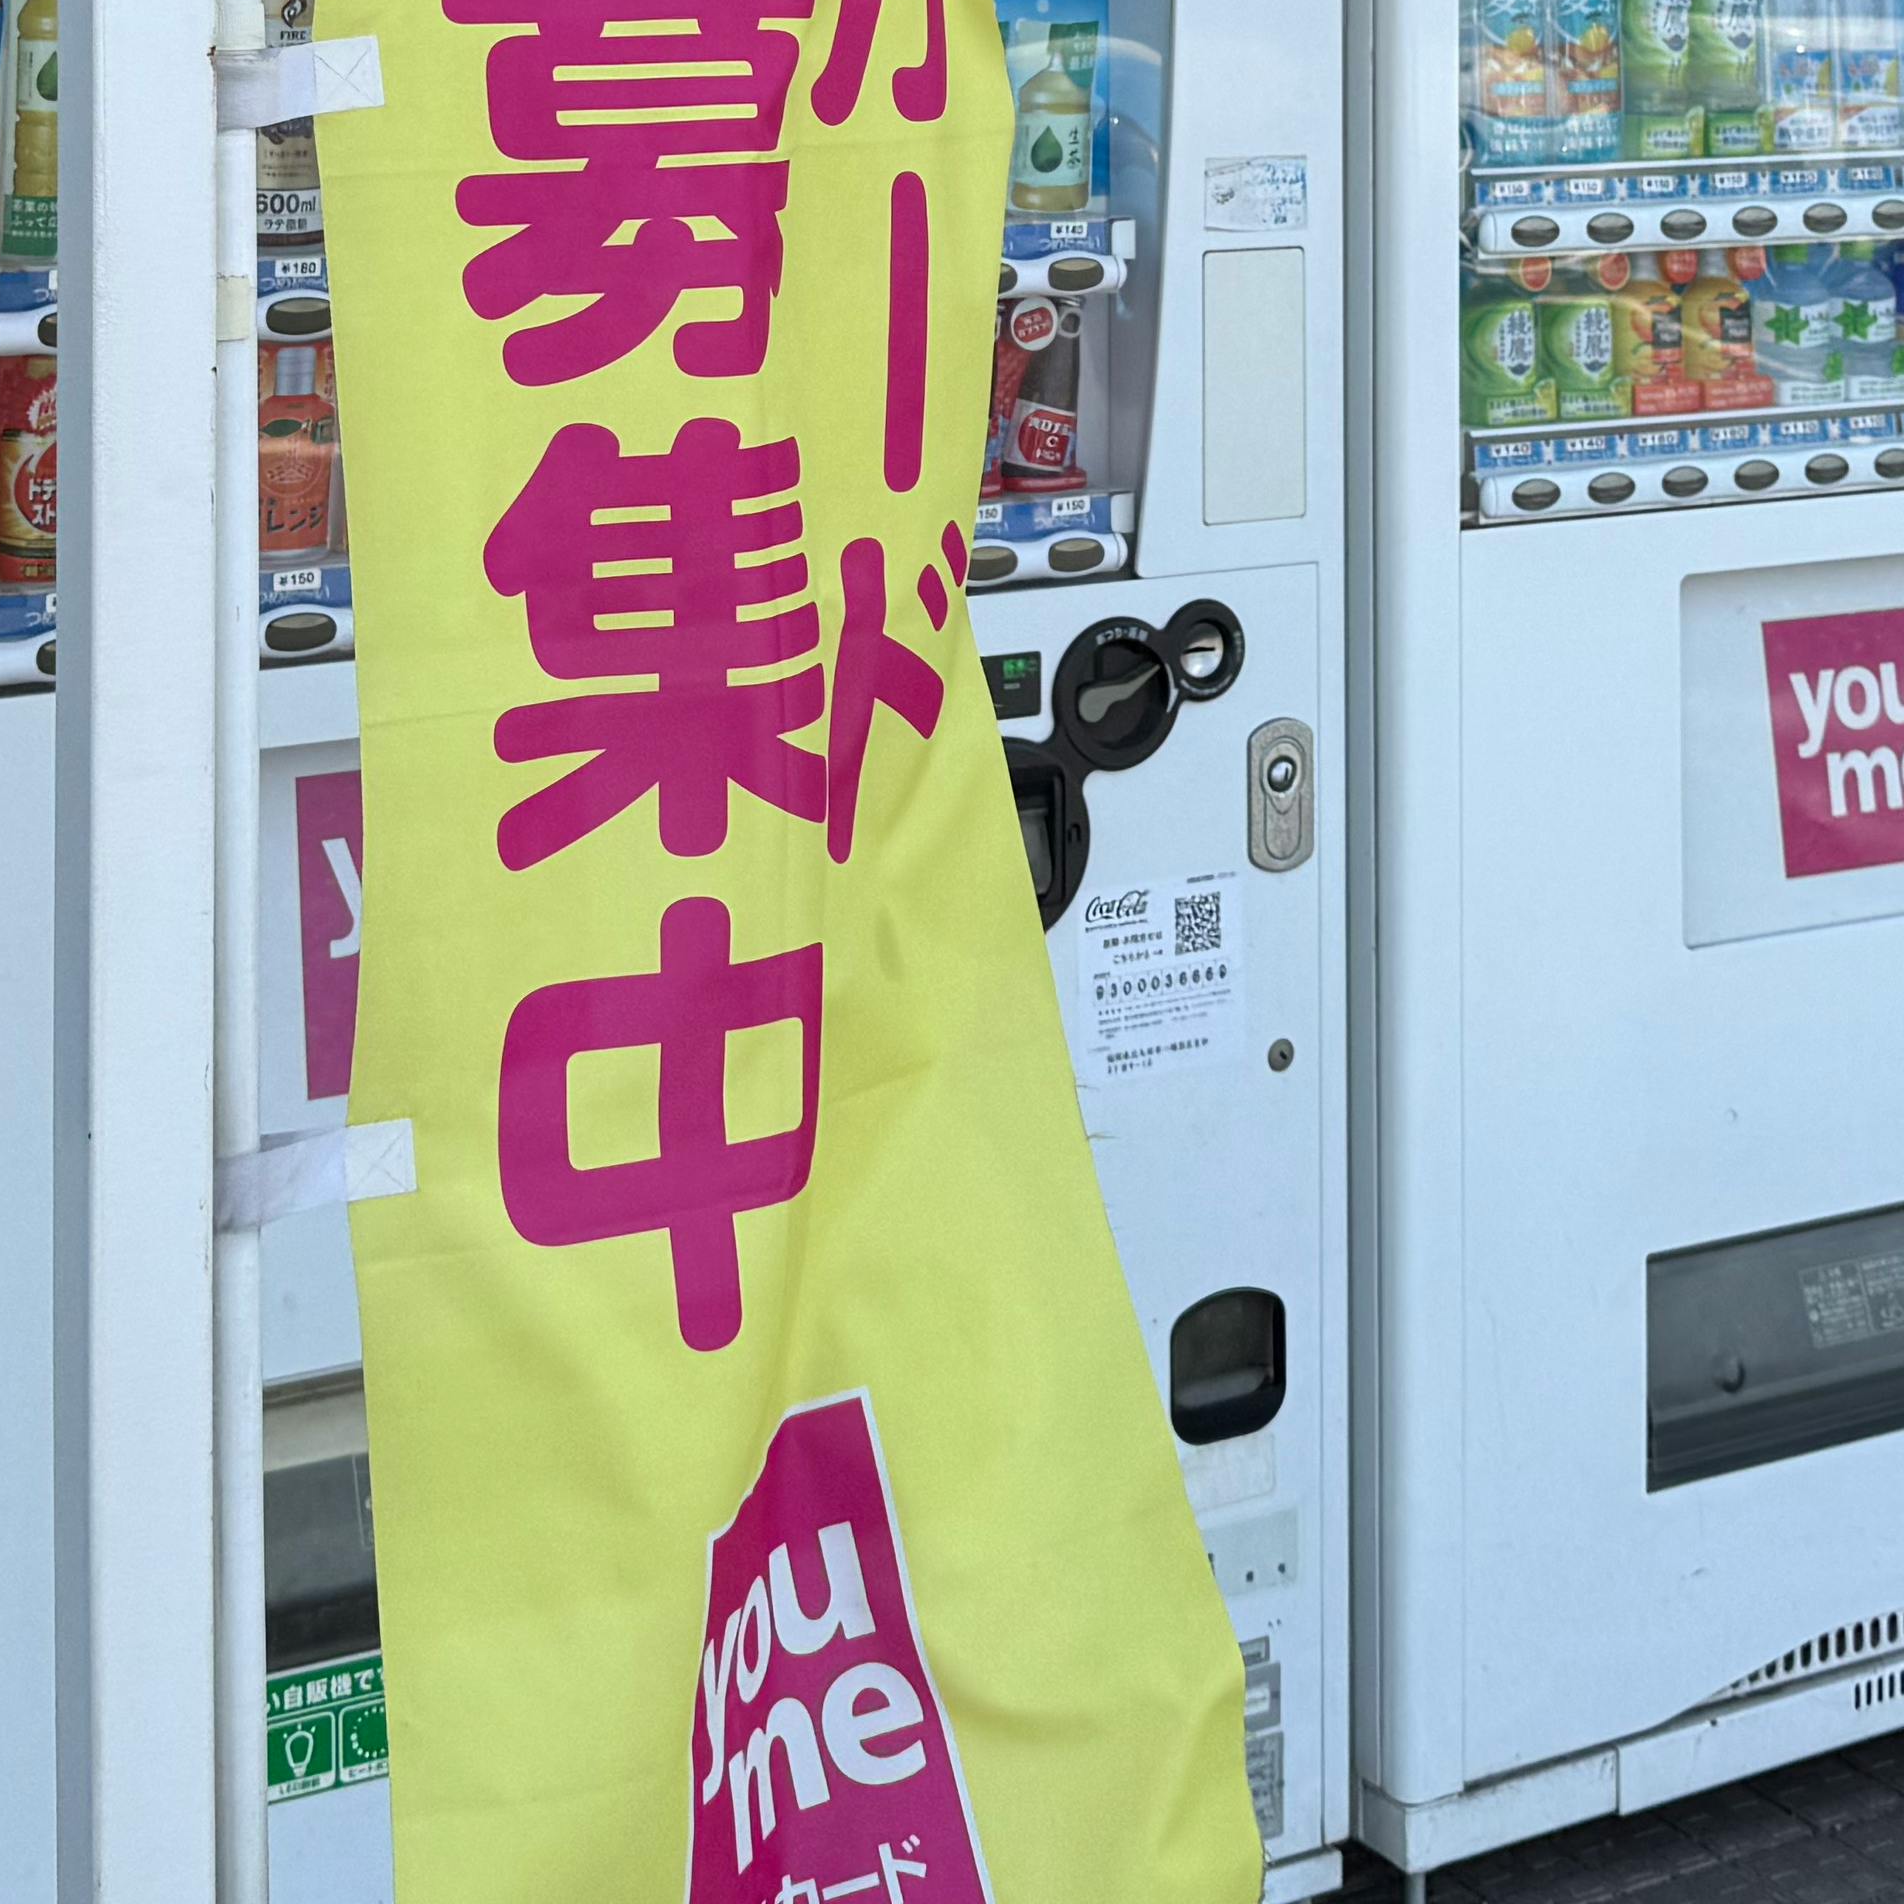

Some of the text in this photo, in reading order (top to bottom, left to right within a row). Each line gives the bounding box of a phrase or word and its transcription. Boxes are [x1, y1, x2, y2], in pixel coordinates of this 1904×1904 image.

[279, 29, 308, 42] FIRE
[256, 194, 316, 215] 600ml
[259, 499, 324, 534] レンジ
[977, 507, 998, 519] 150
[702, 1521, 876, 1807] you
[728, 1659, 927, 1875] me
